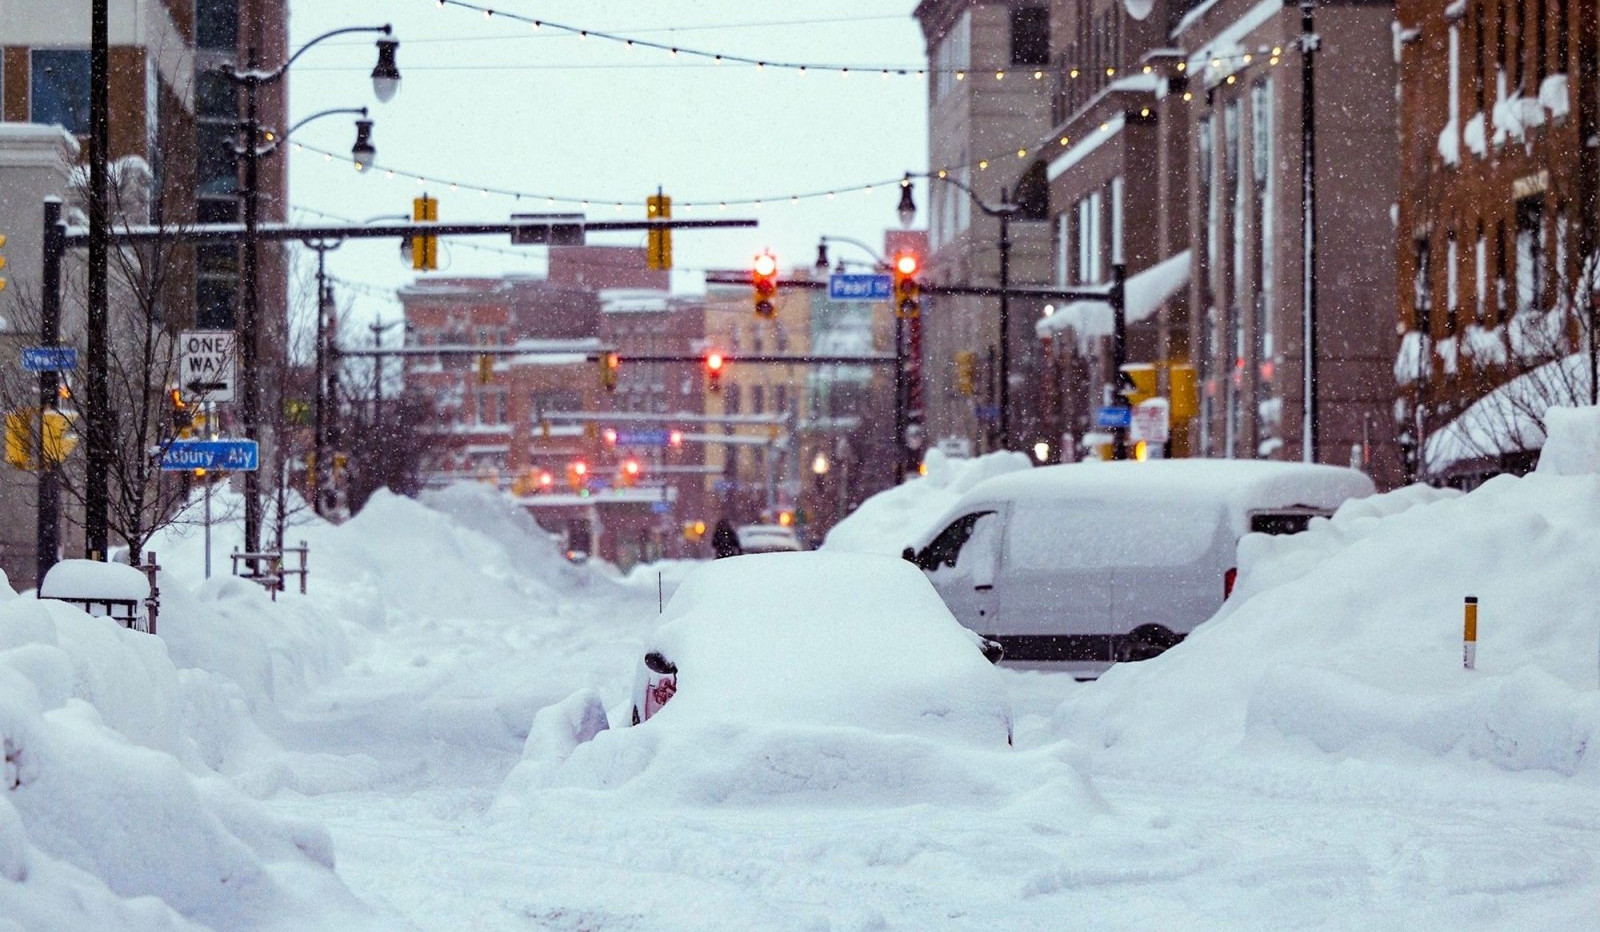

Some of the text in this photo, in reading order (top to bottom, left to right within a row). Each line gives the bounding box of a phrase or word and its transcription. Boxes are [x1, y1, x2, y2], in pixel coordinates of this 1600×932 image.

[833, 280, 872, 295] Pearl
[189, 338, 224, 353] ONE
[189, 357, 223, 372] WAY
[163, 447, 252, 468] Asbury Aly
